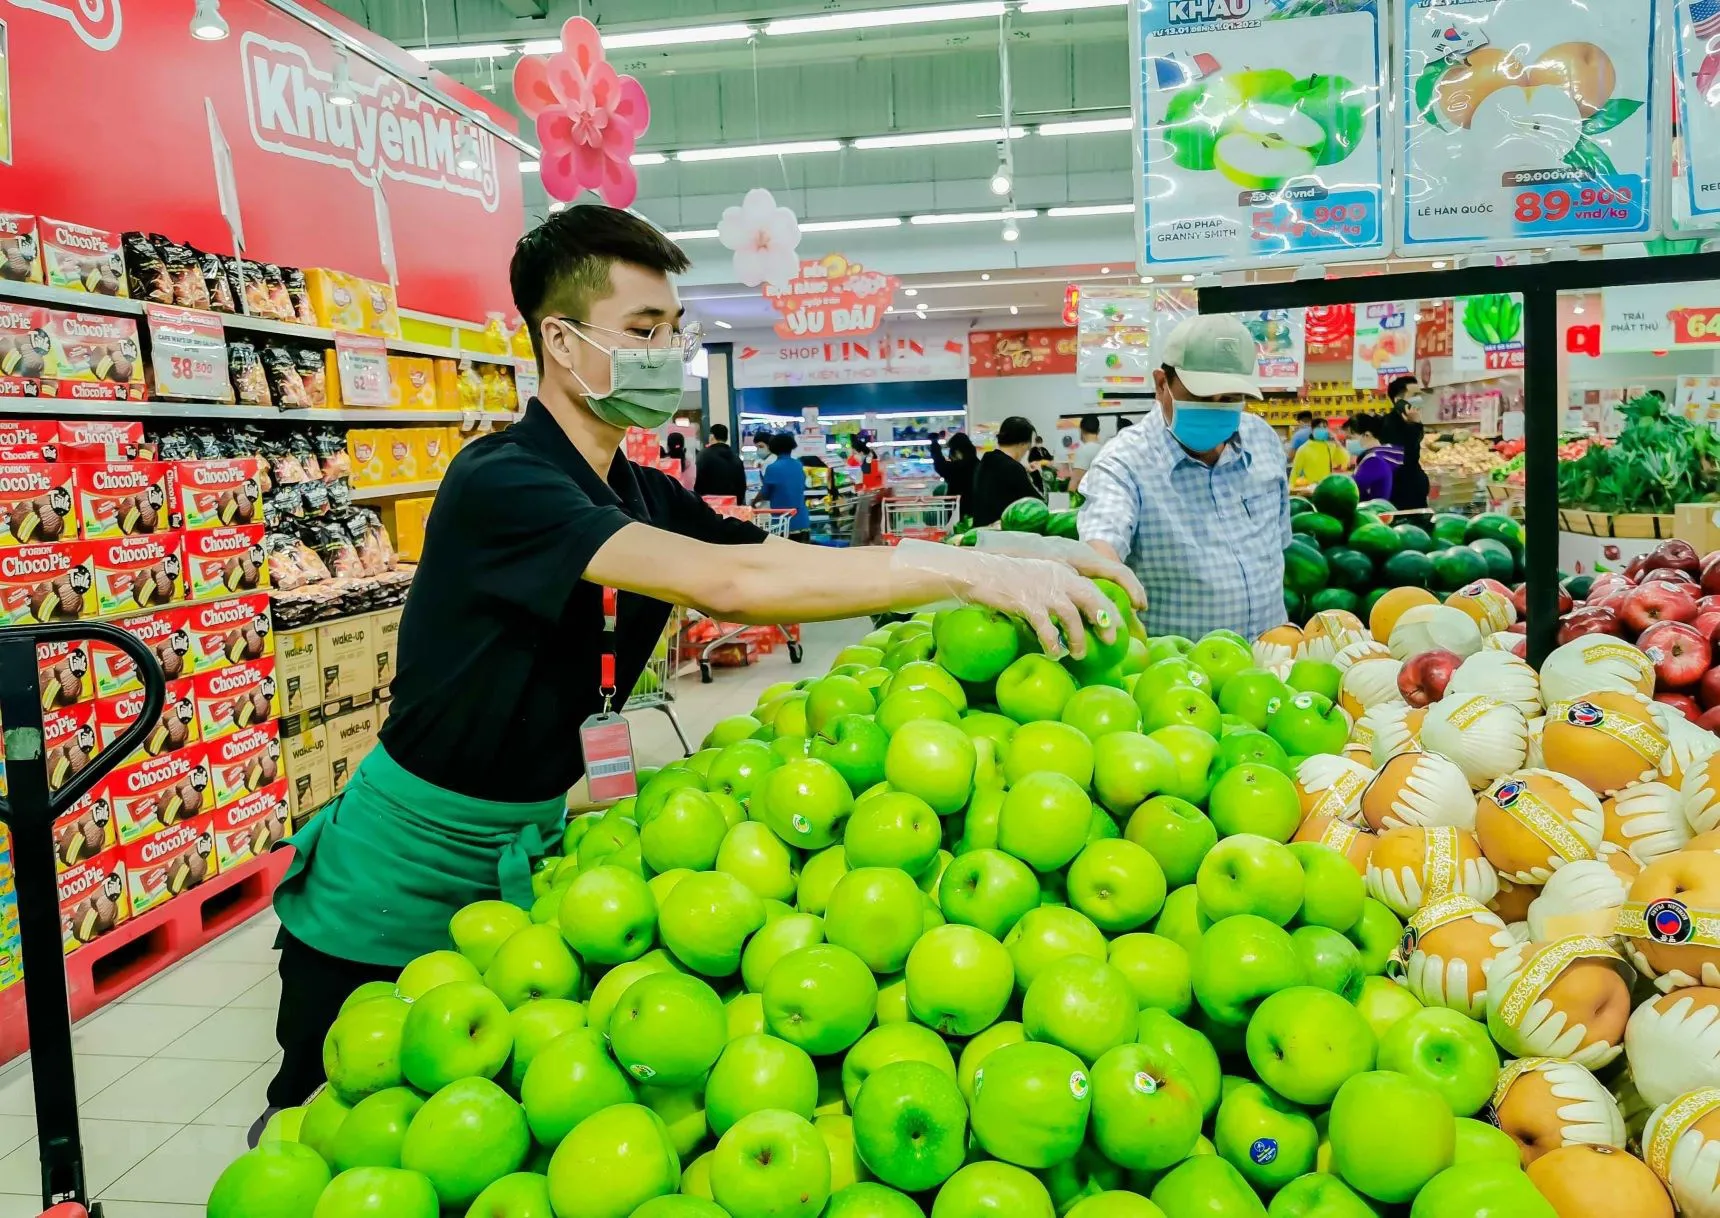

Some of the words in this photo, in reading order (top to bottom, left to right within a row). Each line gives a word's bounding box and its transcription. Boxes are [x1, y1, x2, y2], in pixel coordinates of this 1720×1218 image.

[1209, 19, 1262, 32] 31.01.2022
[1461, 203, 1494, 214] QUỐC
[1575, 207, 1628, 221] vnd/kg
[1157, 232, 1202, 242] GRANNY
[1204, 229, 1237, 239] SMITH
[0, 312, 31, 330] oPie
[780, 347, 820, 360] SHOP
[0, 428, 39, 444] coPie
[0, 473, 51, 492] ocoPie
[1, 552, 73, 577] ChocoPie
[128, 619, 172, 642] ocoPie
[381, 622, 399, 636] wake
[332, 631, 365, 648] wake-up
[284, 642, 314, 659] wake-up
[43, 715, 78, 740] coPie
[339, 719, 371, 739] wake-up
[292, 739, 325, 760] wake-up
[128, 759, 190, 791] ChocoPie
[58, 867, 104, 902] ocoPie
